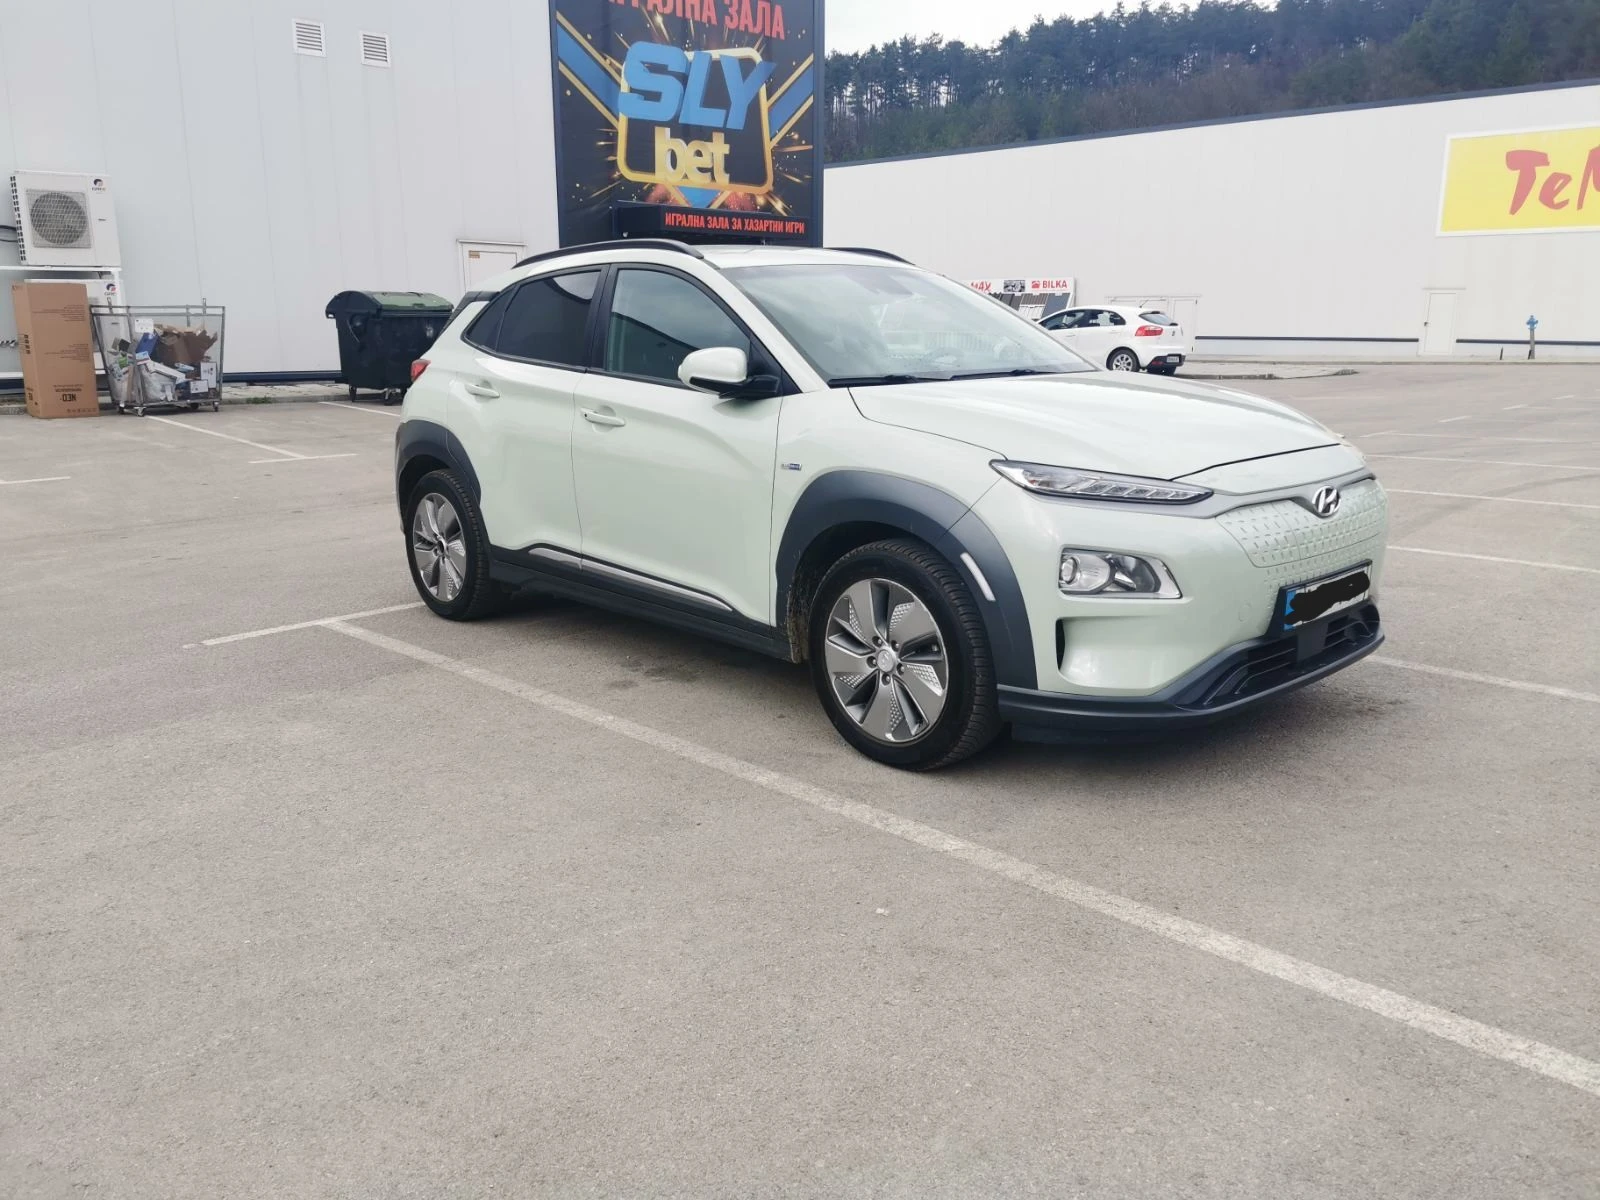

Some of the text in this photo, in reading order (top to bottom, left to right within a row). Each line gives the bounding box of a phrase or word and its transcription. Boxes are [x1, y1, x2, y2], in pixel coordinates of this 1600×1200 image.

[723, 0, 785, 40] ЗАЛА
[618, 41, 776, 130] SLY
[654, 126, 730, 185] bet
[665, 212, 805, 234] ИГРАЛНА ЗАЛА ЗА ХАЗАРТНИ ИГРИ
[1042, 280, 1068, 289] BILKA
